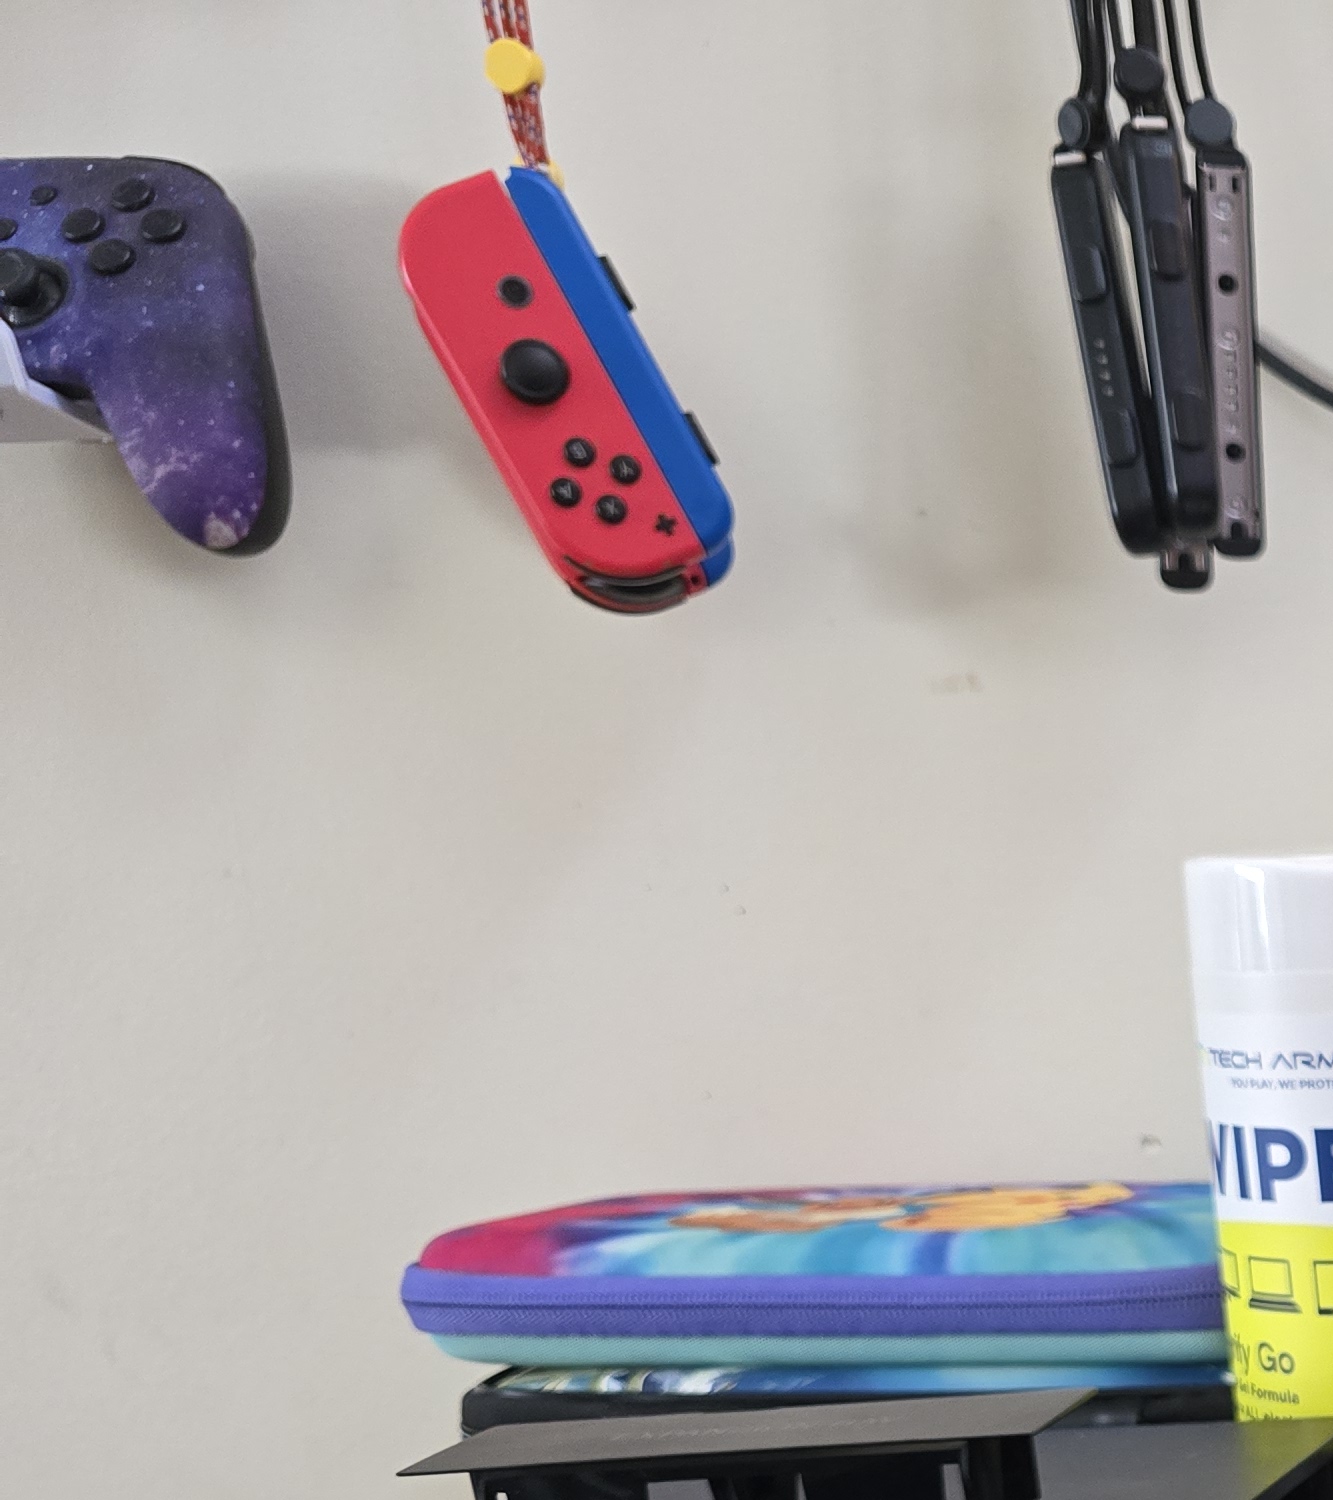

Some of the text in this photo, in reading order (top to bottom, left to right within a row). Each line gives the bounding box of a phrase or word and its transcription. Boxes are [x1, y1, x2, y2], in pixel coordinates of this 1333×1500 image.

[1208, 1046, 1263, 1070] TECH
[1279, 1079, 1296, 1090] WE
[1256, 1340, 1297, 1376] Go
[1251, 1382, 1301, 1405] Formula
